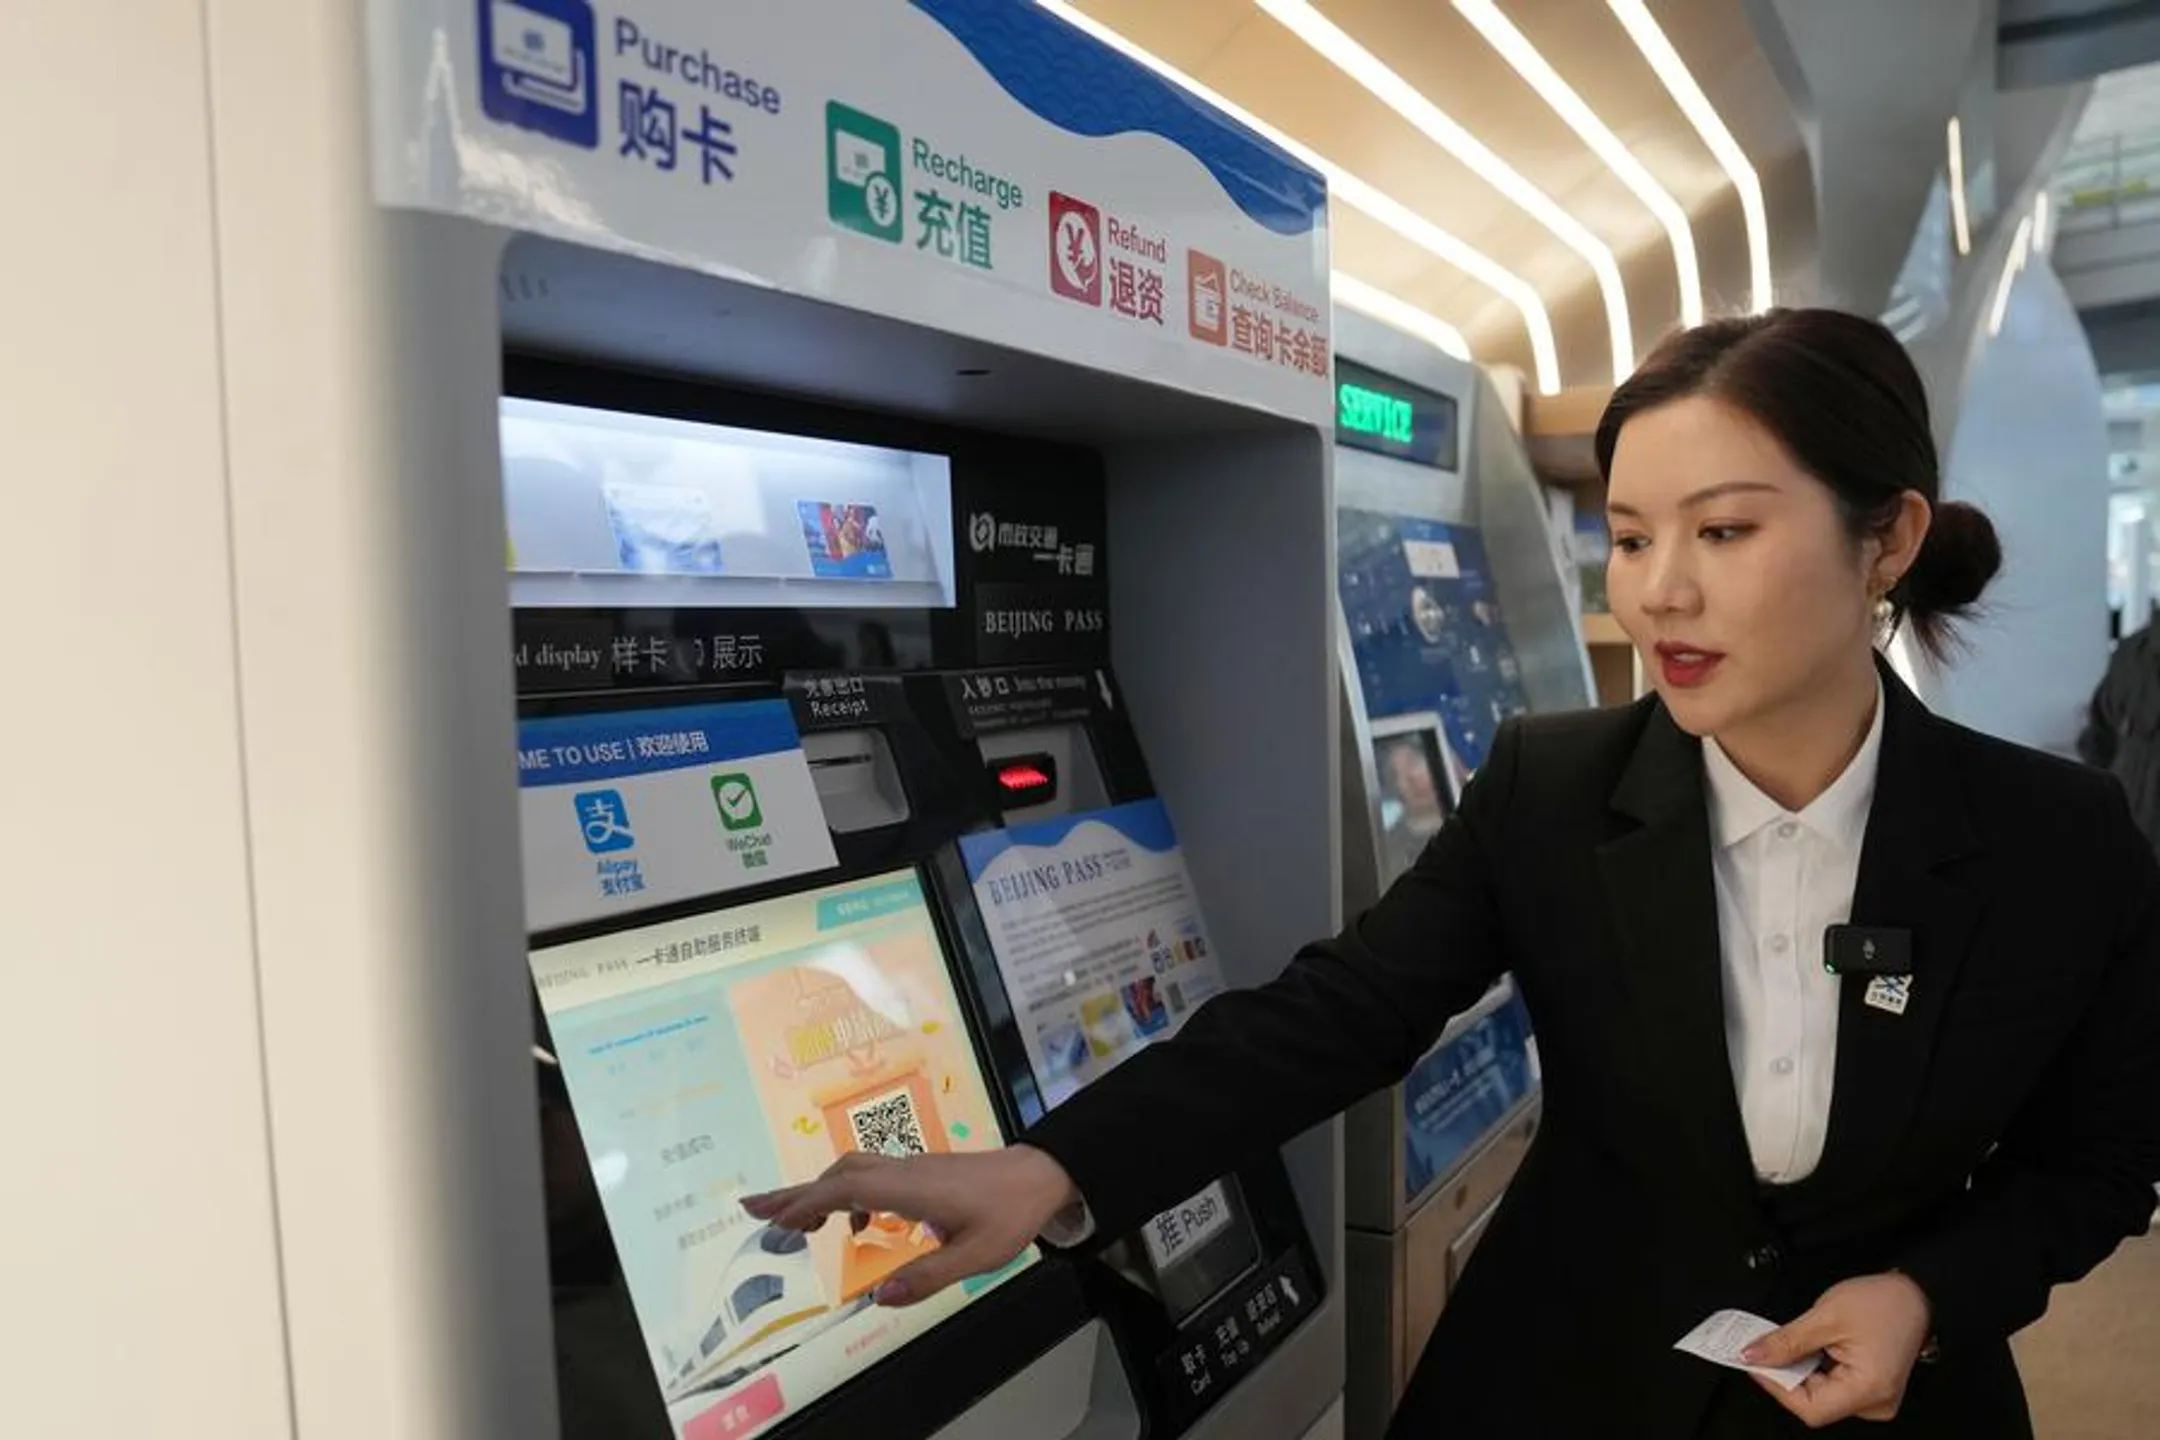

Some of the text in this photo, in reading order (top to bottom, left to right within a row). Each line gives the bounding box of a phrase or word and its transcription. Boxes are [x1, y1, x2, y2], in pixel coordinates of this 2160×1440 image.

[615, 16, 781, 115] Purchase
[617, 79, 738, 186] 购卡
[912, 137, 1023, 210] Recharge
[913, 187, 993, 270] 充值
[1108, 216, 1167, 264] Refund
[1108, 257, 1164, 325] 退资
[1229, 268, 1269, 302] Check
[1231, 304, 1327, 378] 查询卡余额
[1339, 383, 1413, 443] SERVICE
[985, 609, 1104, 639] BEIJING PASS
[535, 643, 602, 672] display
[811, 699, 869, 719] Receipt
[551, 745, 582, 766] TO
[584, 741, 625, 764] USE
[636, 731, 710, 757] 欢迎使用
[726, 834, 773, 853] WeChat
[600, 874, 646, 897] 支付宝
[988, 864, 1060, 905] BEIJING
[1064, 854, 1104, 883] PASS
[1182, 1197, 1217, 1239] Push
